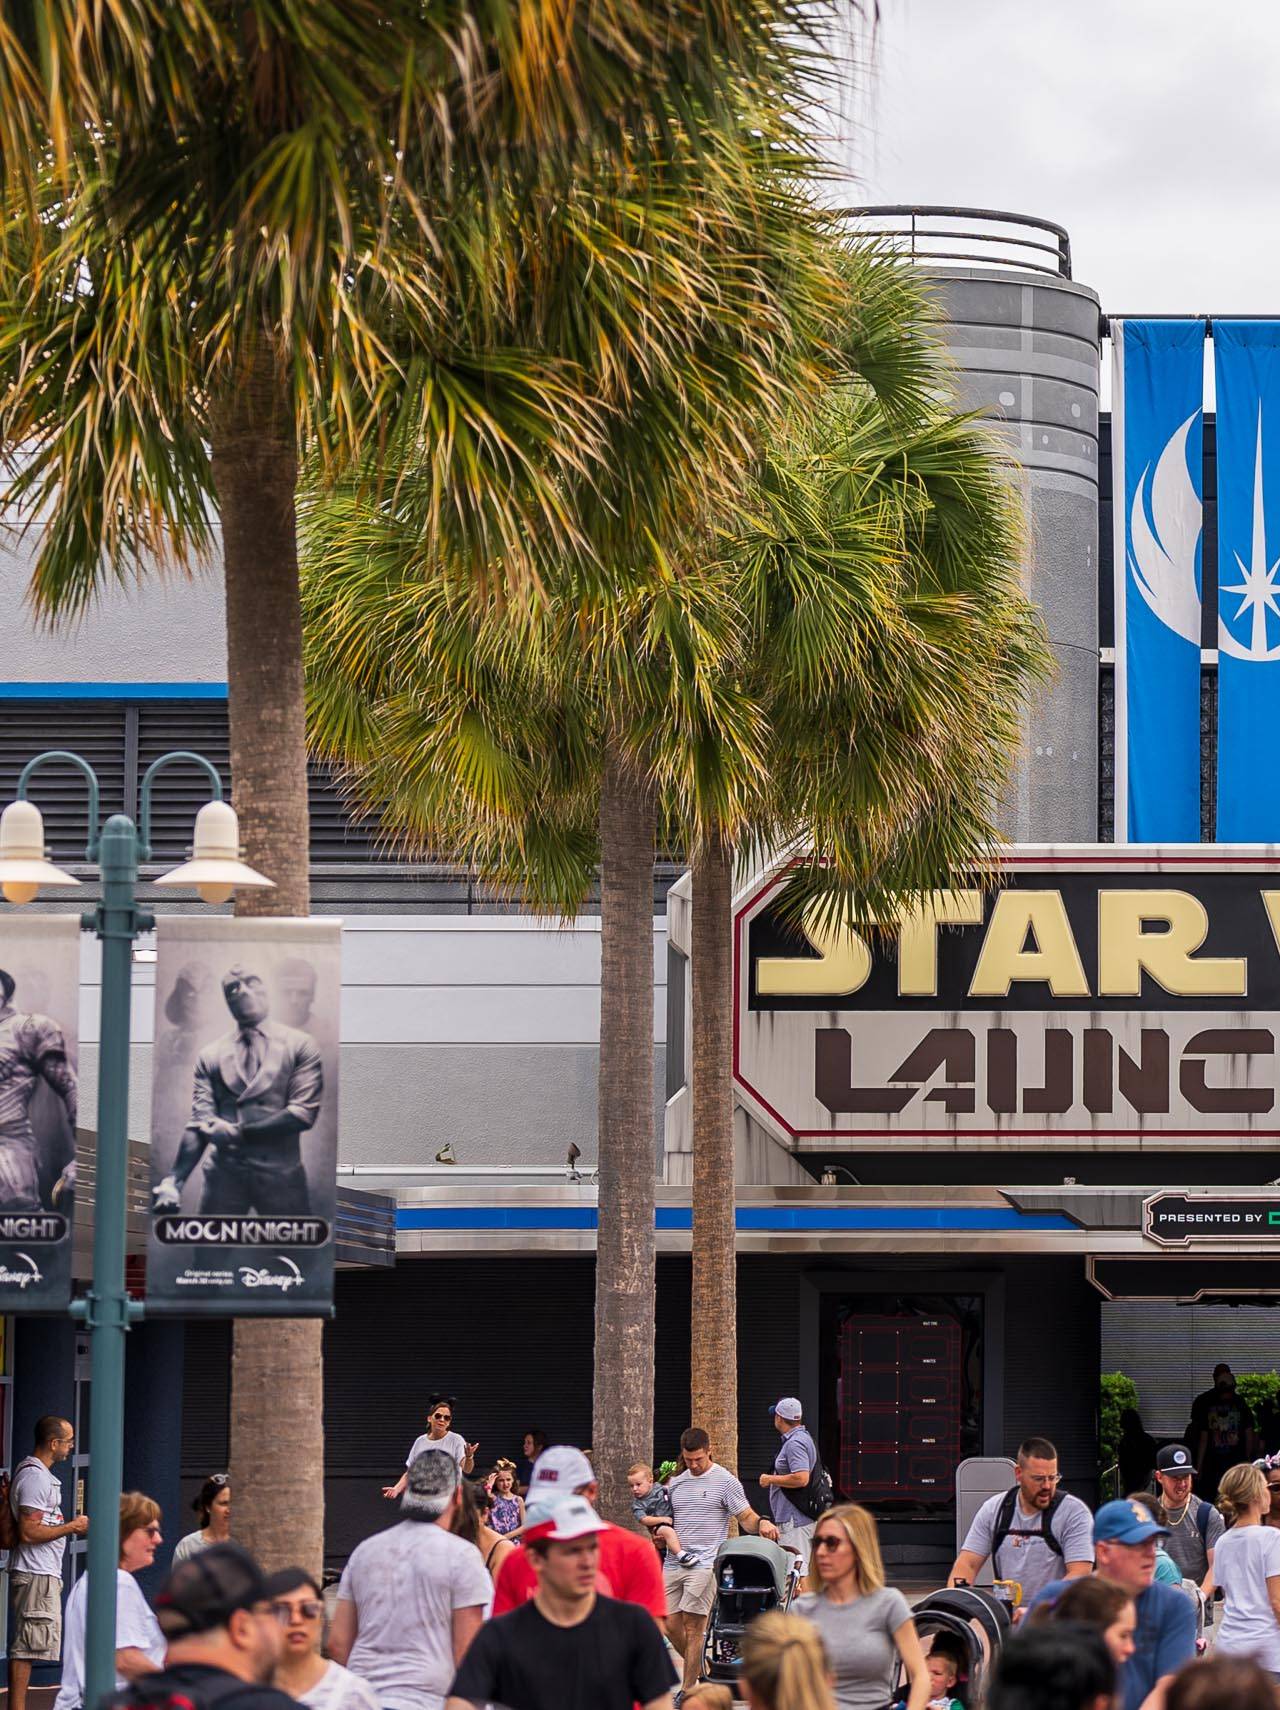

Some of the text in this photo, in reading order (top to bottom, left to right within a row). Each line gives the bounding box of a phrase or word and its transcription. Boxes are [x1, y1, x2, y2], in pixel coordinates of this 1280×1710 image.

[755, 888, 1248, 997] STAR
[0, 1218, 58, 1238] NIGHT
[1159, 1213, 1262, 1222] PRESENTED BY
[241, 1221, 321, 1243] KNIGHT
